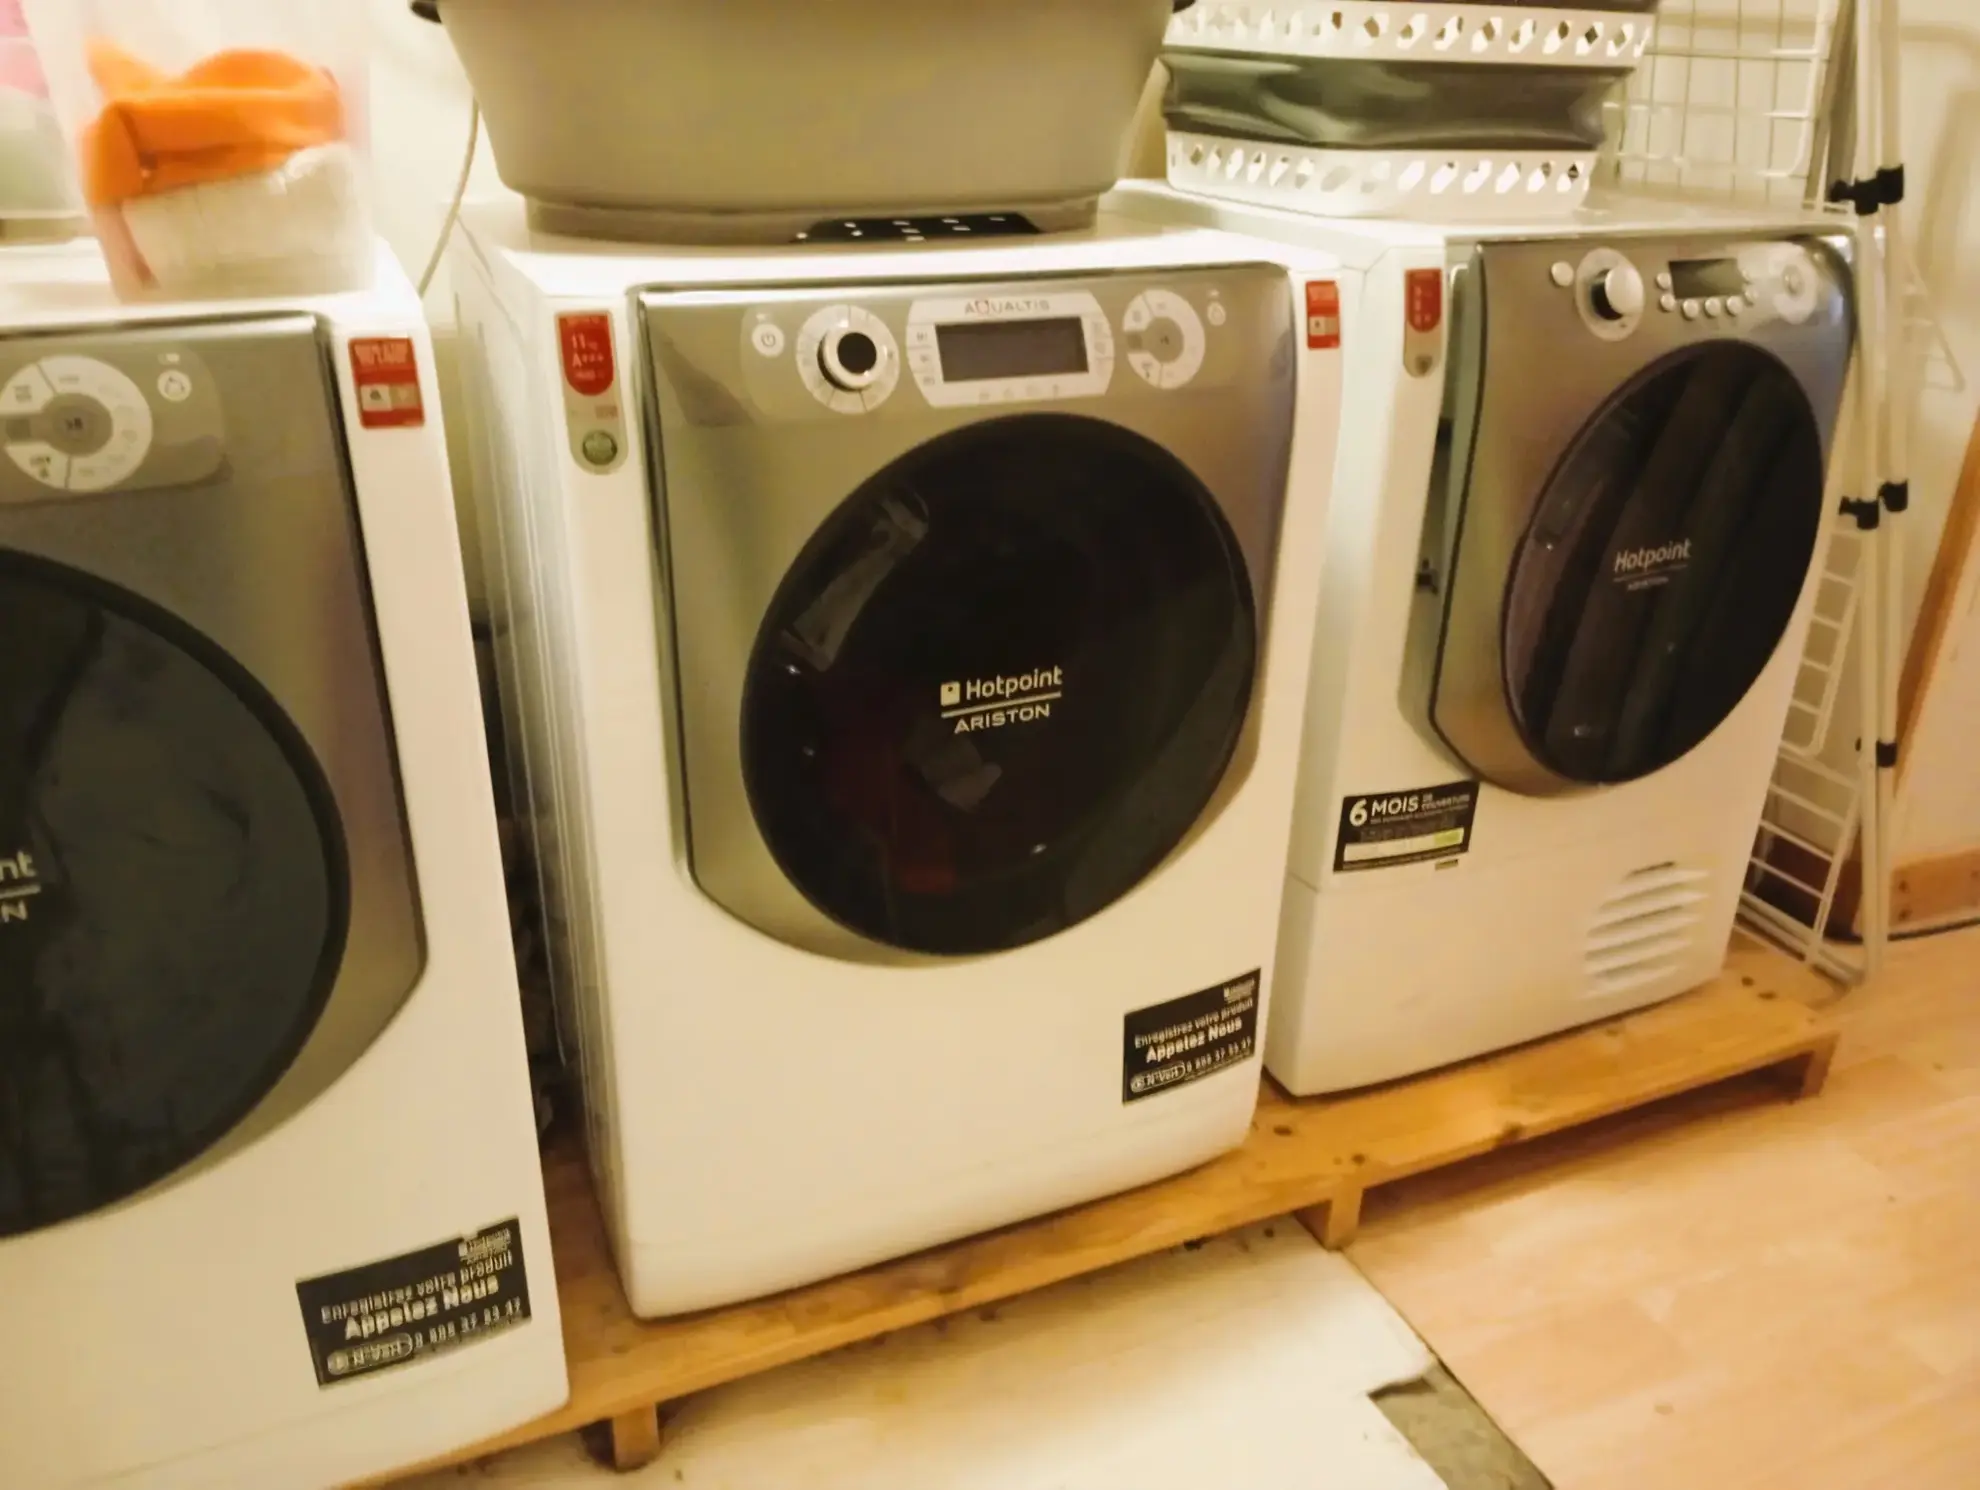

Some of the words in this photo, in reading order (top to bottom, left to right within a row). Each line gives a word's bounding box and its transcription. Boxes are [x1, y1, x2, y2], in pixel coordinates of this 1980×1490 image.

[964, 299, 1050, 315] AQUALTIS
[1614, 537, 1692, 573] Hotpoint
[966, 665, 1063, 700] Hotpoint
[954, 703, 1050, 735] ARISTON
[1349, 798, 1368, 827] 6
[1371, 796, 1419, 817] MOIS
[1146, 1031, 1206, 1064] Appelez
[1208, 1016, 1243, 1042] Nous
[344, 1296, 439, 1341] Appelez
[442, 1274, 500, 1311] Nous
